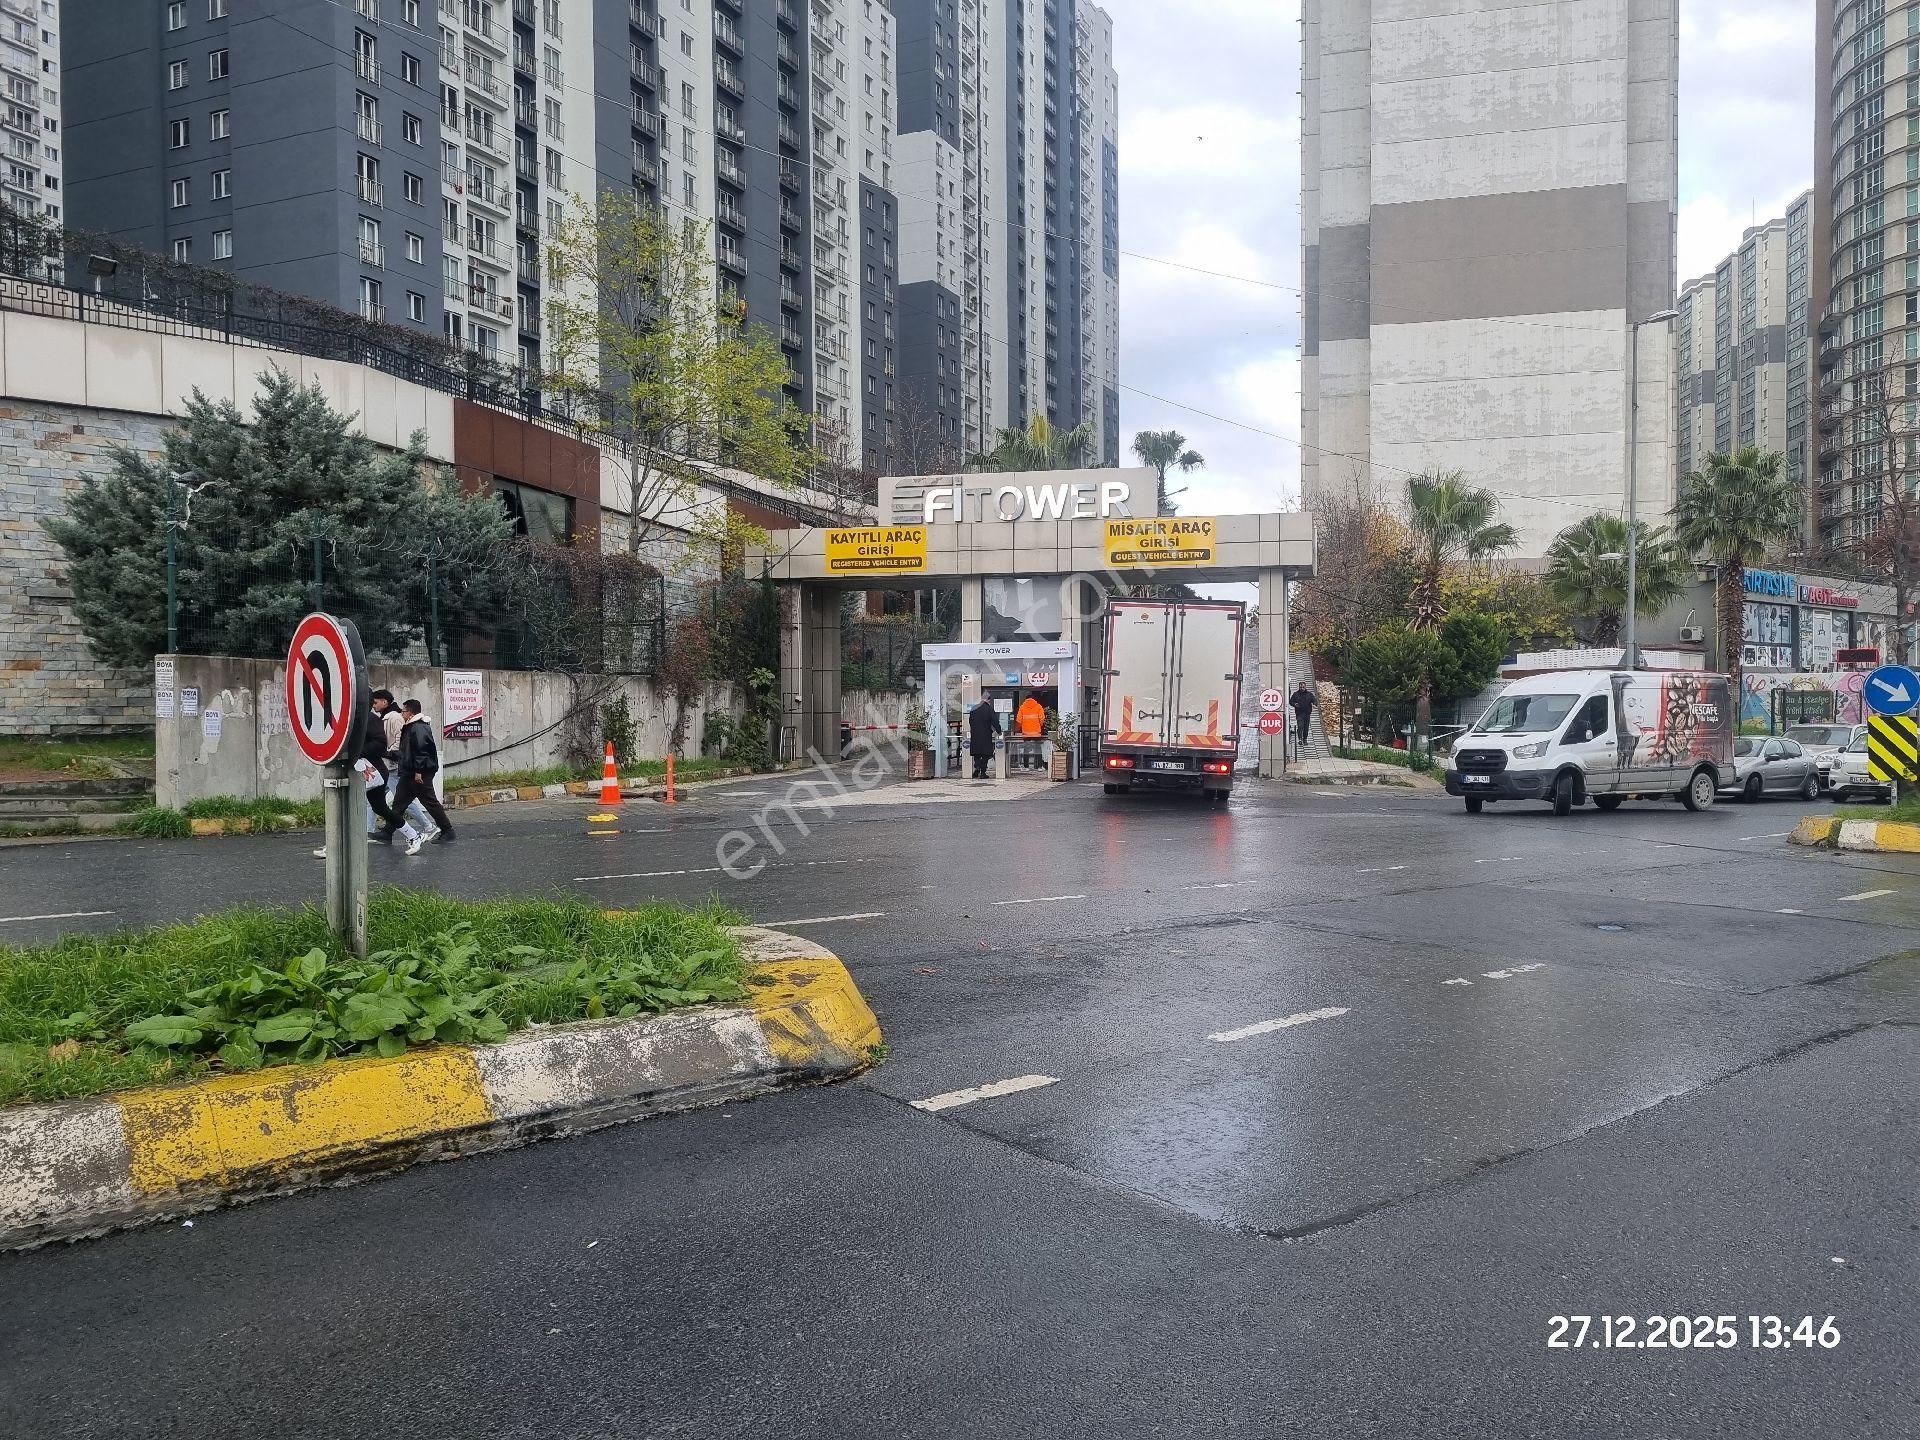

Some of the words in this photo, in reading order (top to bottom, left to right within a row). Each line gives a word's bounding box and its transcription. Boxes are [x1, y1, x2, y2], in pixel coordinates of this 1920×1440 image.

[1109, 520, 1167, 537] MİSAFİR
[1170, 521, 1212, 537] ARAÇ
[830, 531, 881, 544] KAYITLI
[885, 530, 922, 545] ARAÇ
[1139, 536, 1180, 549] GİRİŞİ
[857, 544, 895, 556] GİRİŞİ
[1143, 552, 1177, 560] VEHICLE
[1178, 551, 1205, 559] ENTRY
[832, 560, 871, 568] REGISTERED
[872, 559, 899, 567] VEHICLE
[900, 558, 921, 566] ENTRY
[985, 647, 1011, 655] TOWER
[1263, 694, 1279, 703] 20
[1261, 719, 1282, 728] DUR
